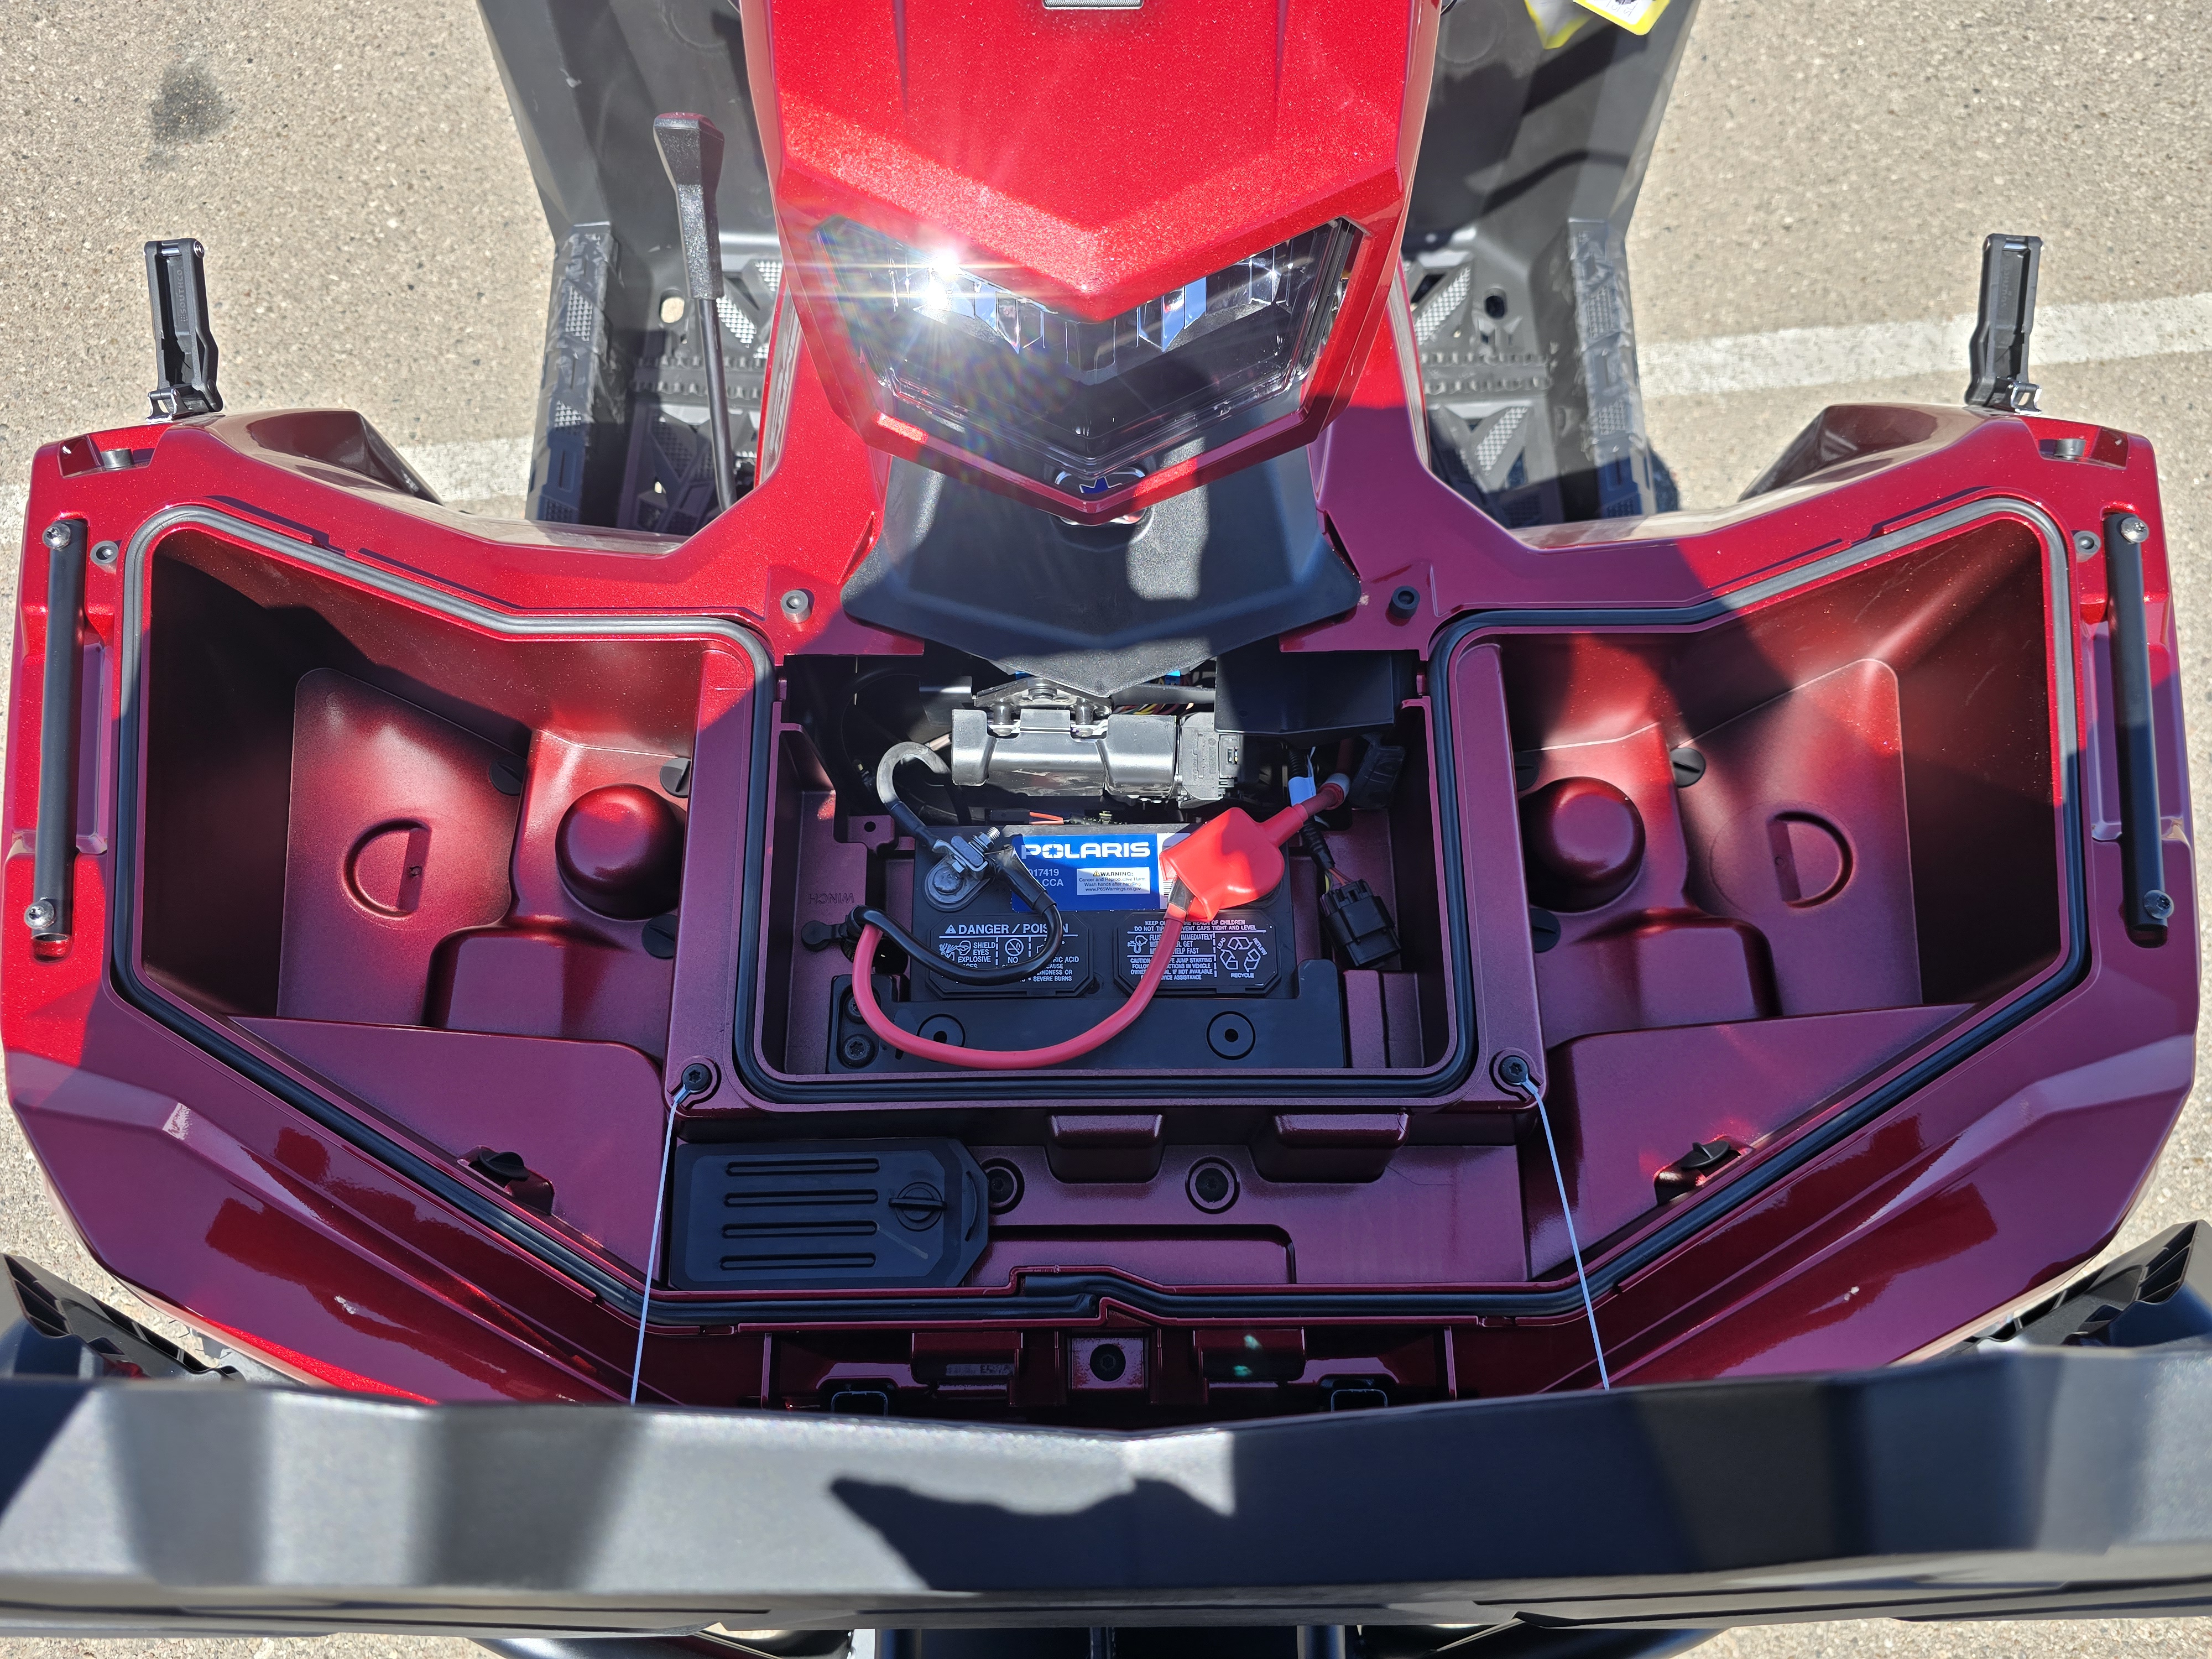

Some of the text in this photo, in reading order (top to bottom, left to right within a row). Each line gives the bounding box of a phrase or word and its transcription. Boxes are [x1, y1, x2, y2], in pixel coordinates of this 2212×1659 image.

[1021, 842, 1151, 859] POLARIS
[1042, 878, 1064, 886] CCA
[808, 893, 854, 905] WINCH
[958, 924, 1009, 934] DANGER
[1022, 923, 1068, 933] POISN
[1217, 937, 1226, 950] LEAD
[1253, 937, 1267, 956] RETURN
